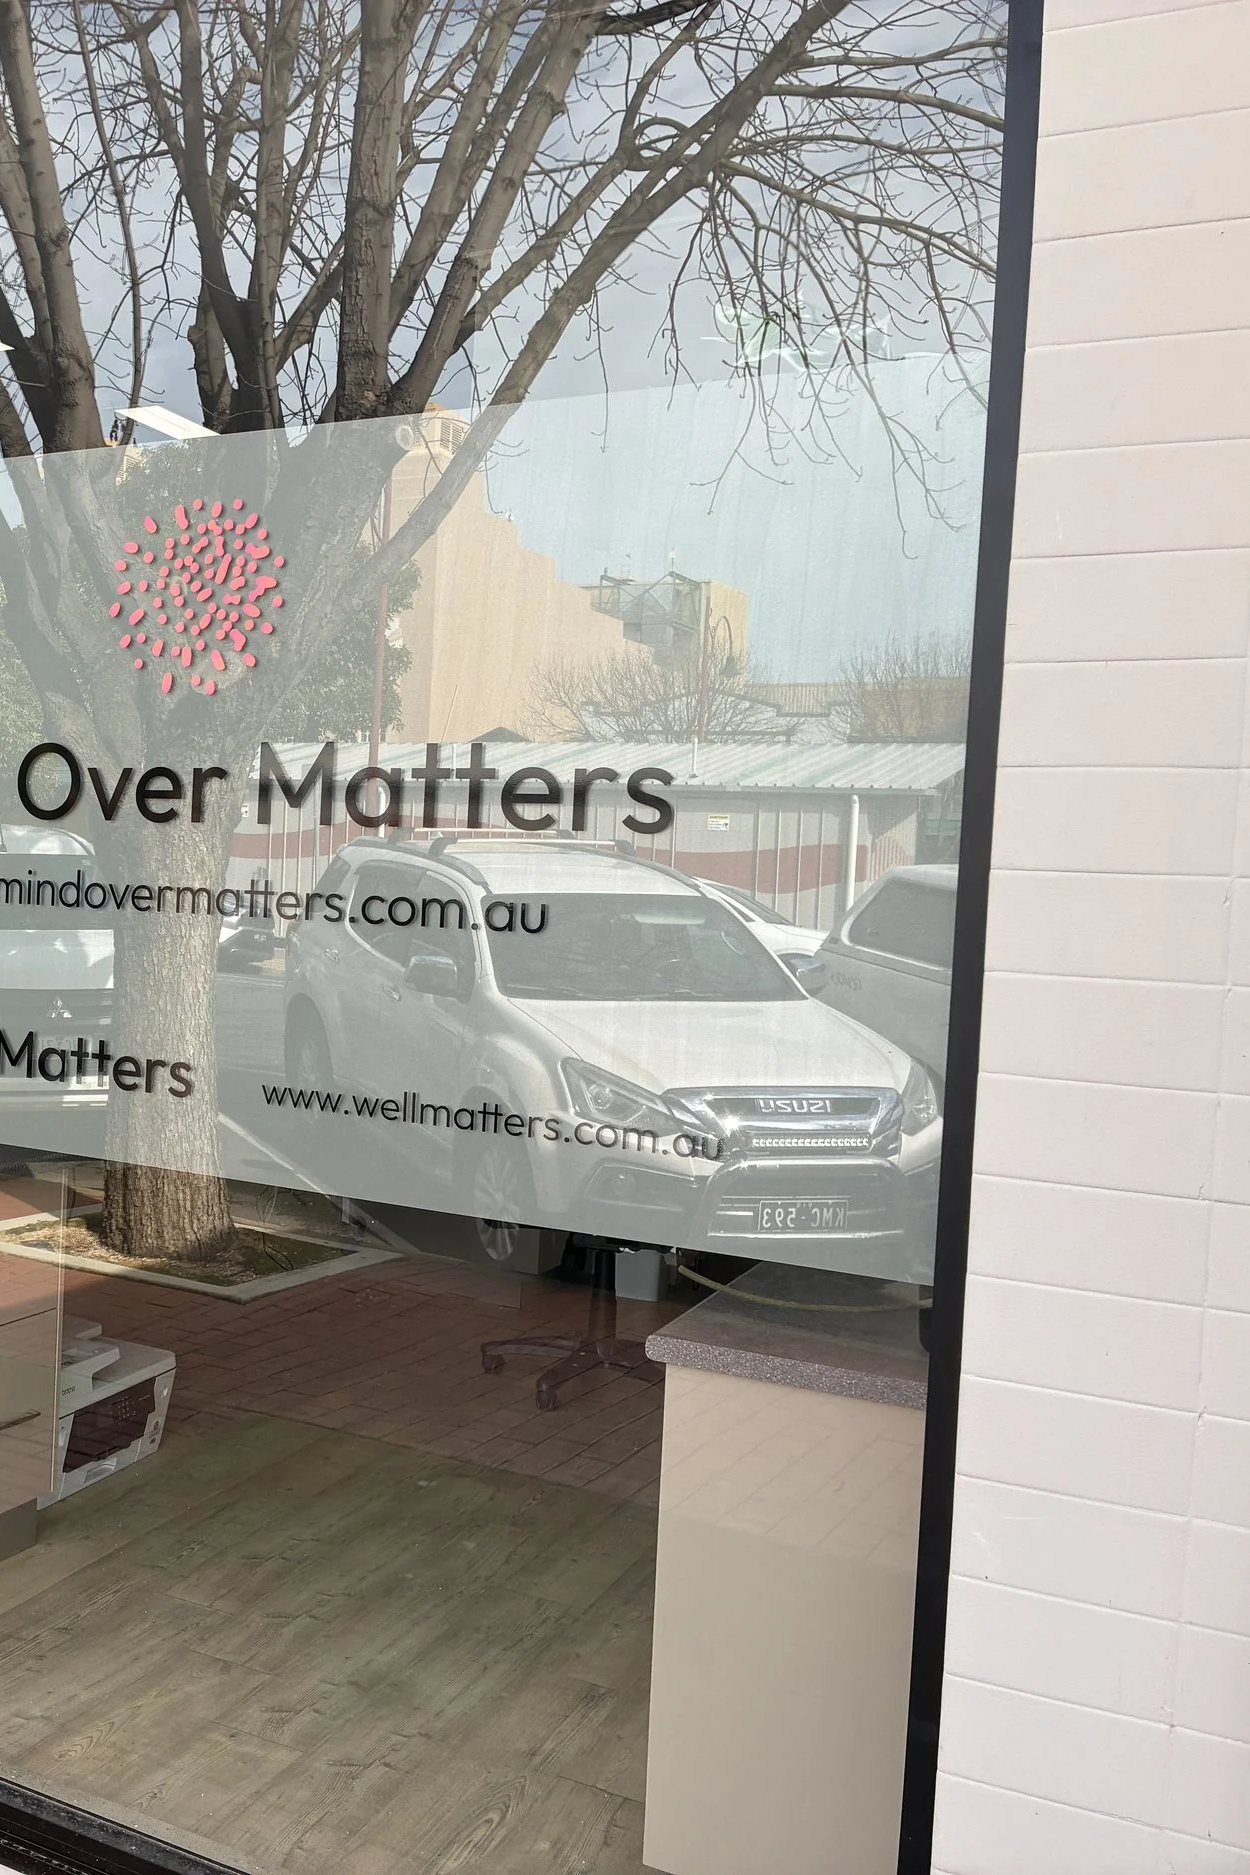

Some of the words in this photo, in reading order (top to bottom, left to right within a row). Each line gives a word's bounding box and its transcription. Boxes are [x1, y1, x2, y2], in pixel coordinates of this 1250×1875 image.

[17, 742, 227, 824] Over
[259, 741, 675, 833] Matters
[262, 1083, 724, 1161] www.wellmatters.com.au
